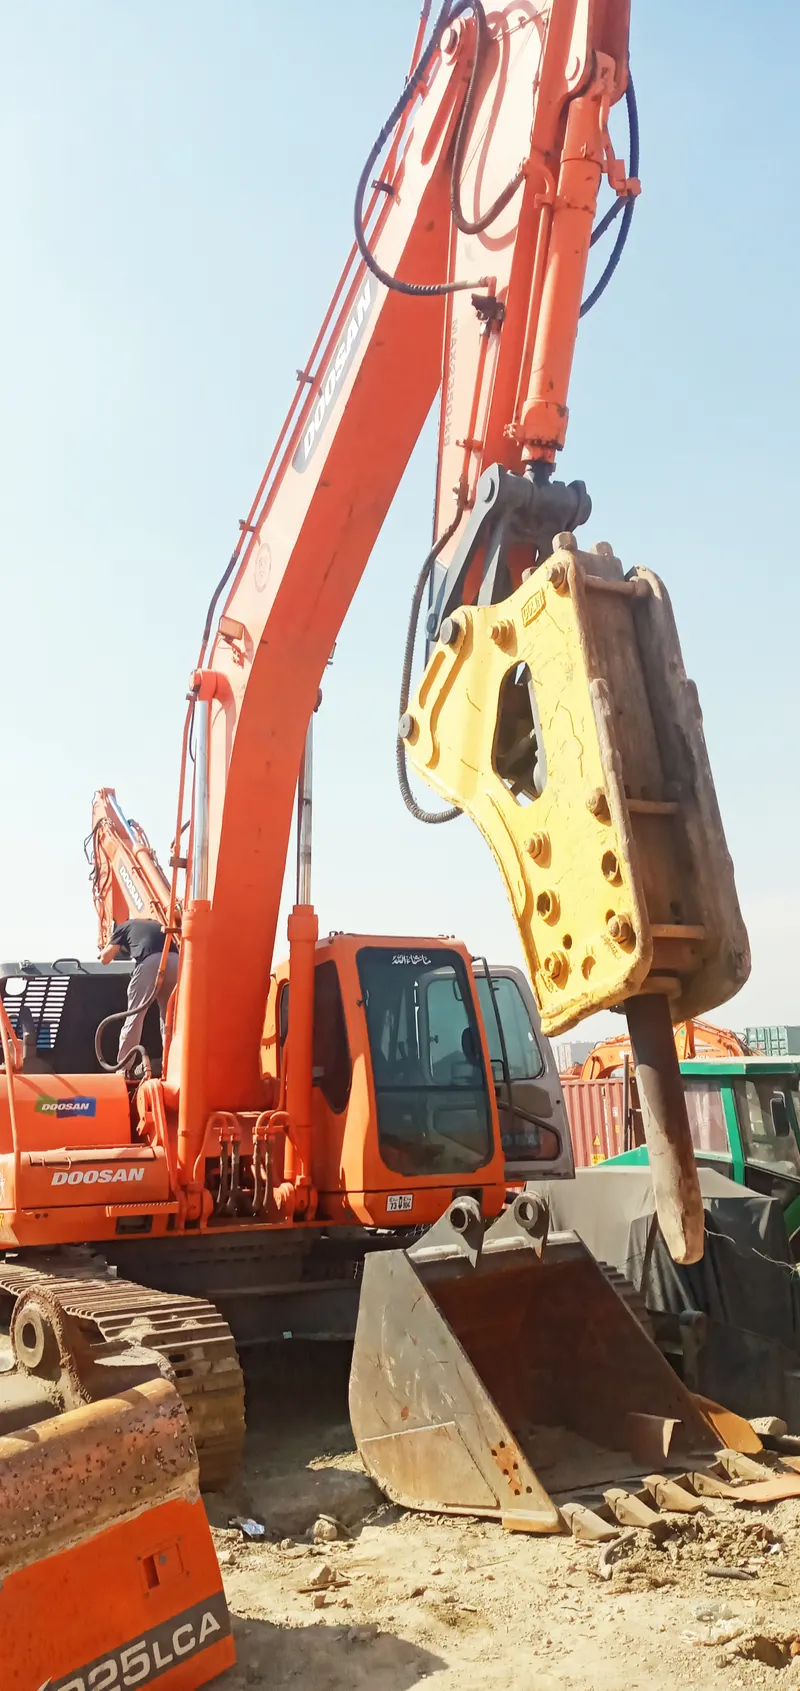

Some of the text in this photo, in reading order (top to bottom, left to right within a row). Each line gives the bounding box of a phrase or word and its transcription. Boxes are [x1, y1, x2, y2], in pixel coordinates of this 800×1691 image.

[303, 279, 371, 460] DOOSAN
[119, 866, 143, 911] DOOSAN
[41, 1102, 90, 1111] DOOSAN
[51, 1167, 145, 1186] DOOSAN
